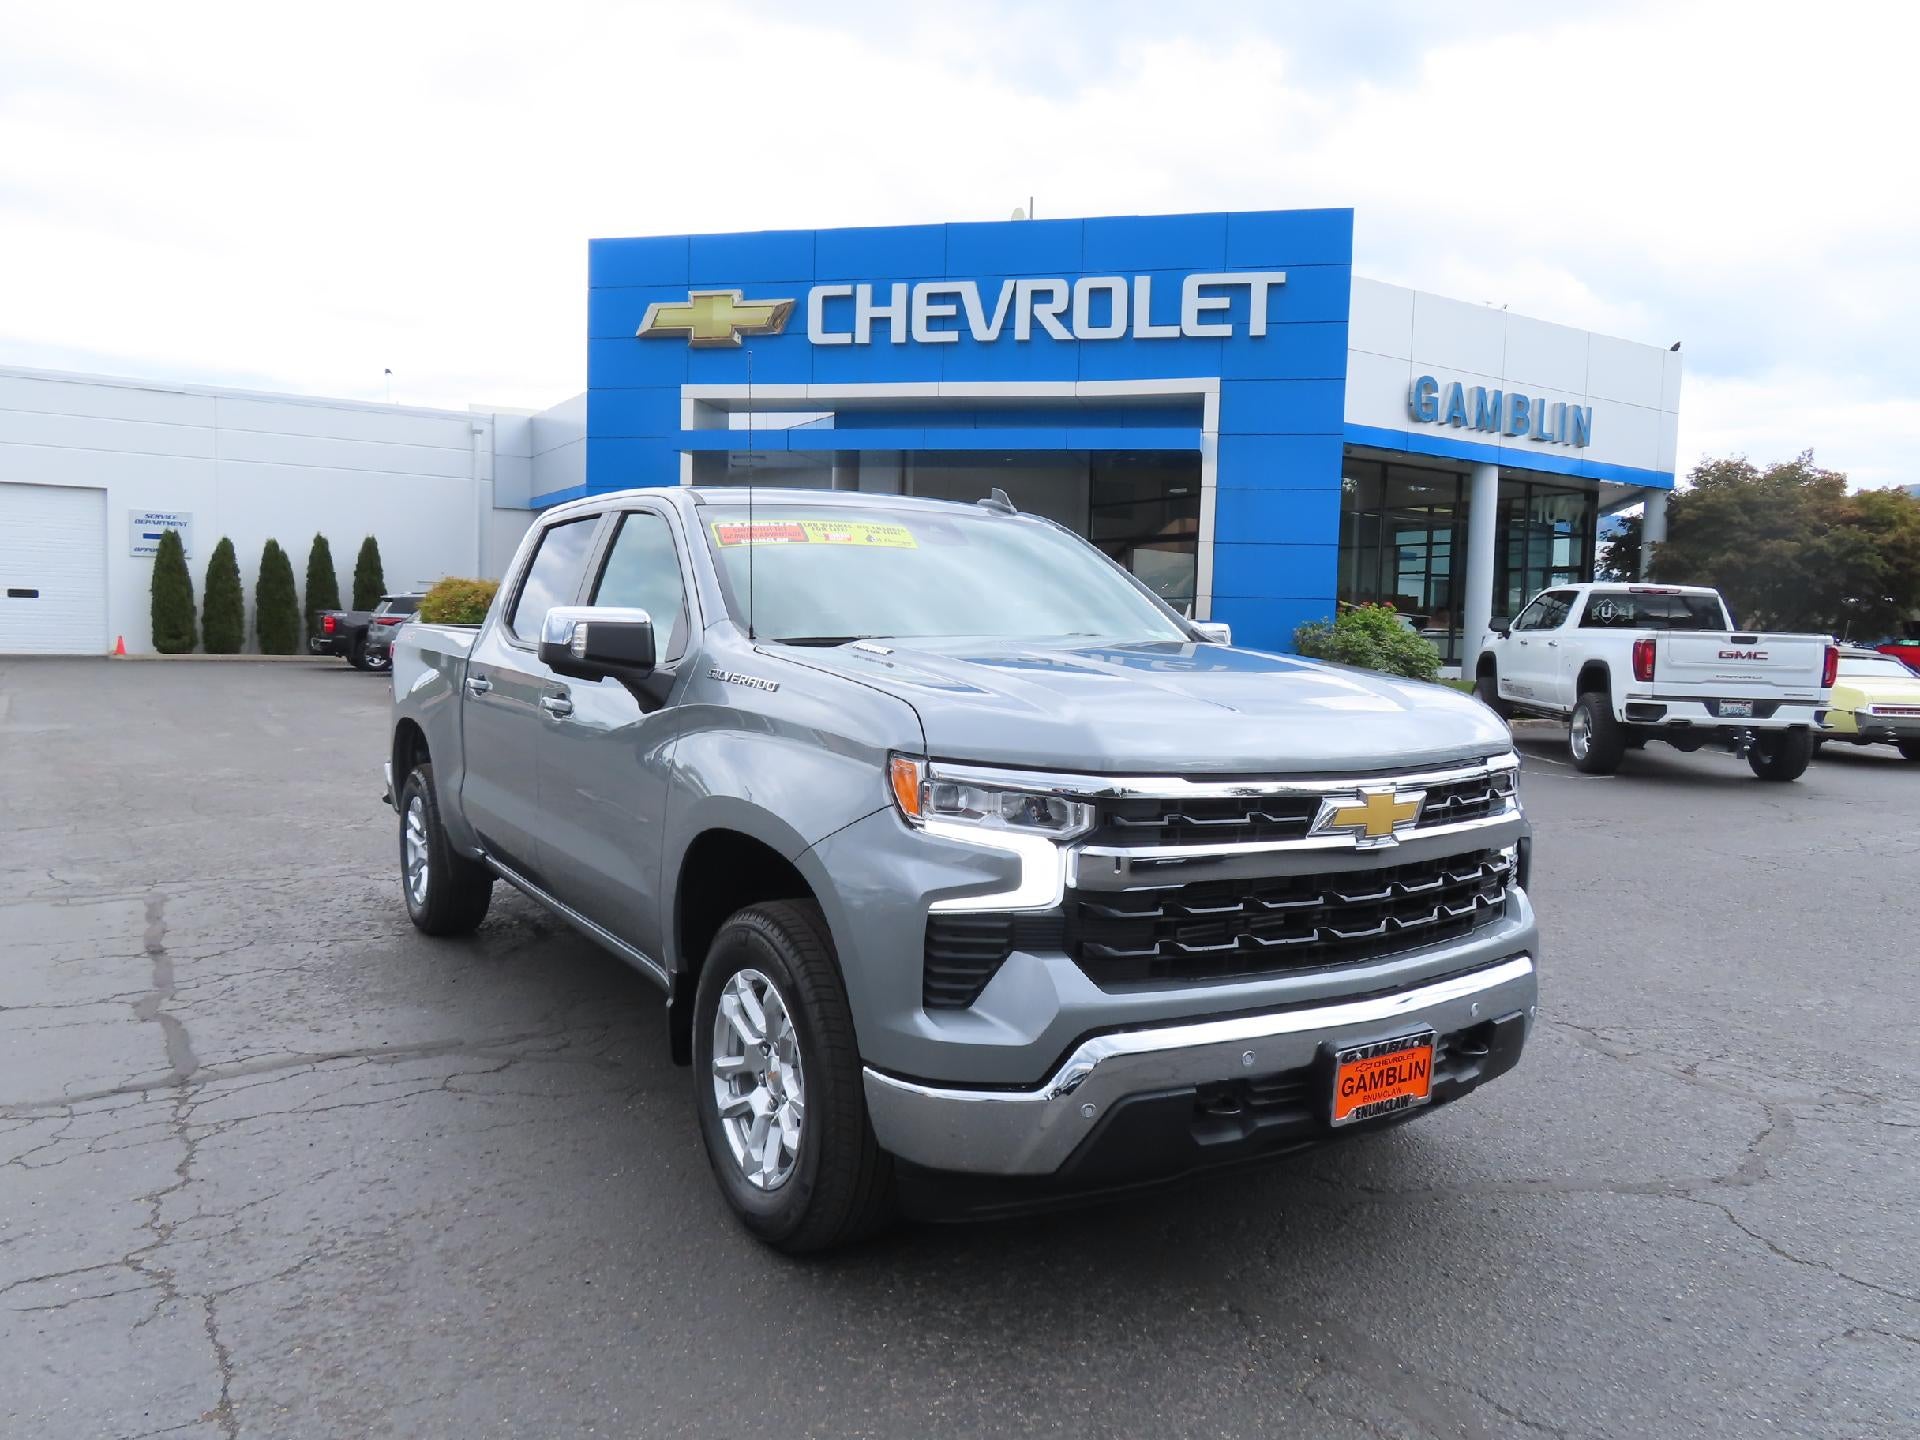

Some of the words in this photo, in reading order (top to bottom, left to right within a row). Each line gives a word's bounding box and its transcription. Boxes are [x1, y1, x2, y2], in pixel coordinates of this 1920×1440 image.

[807, 271, 1287, 345] CHEVROLET
[1410, 375, 1593, 448] GAMBLIN
[134, 519, 188, 527] DEPARTMENT
[1718, 650, 1769, 661] GMC
[707, 668, 780, 692] SILVERADO
[1374, 1052, 1416, 1068] CHEVROLET
[1341, 1058, 1427, 1098] GAMBLIN
[1355, 1094, 1411, 1119] ENUMCLAW
[1362, 1086, 1402, 1103] ENUMCLAW
